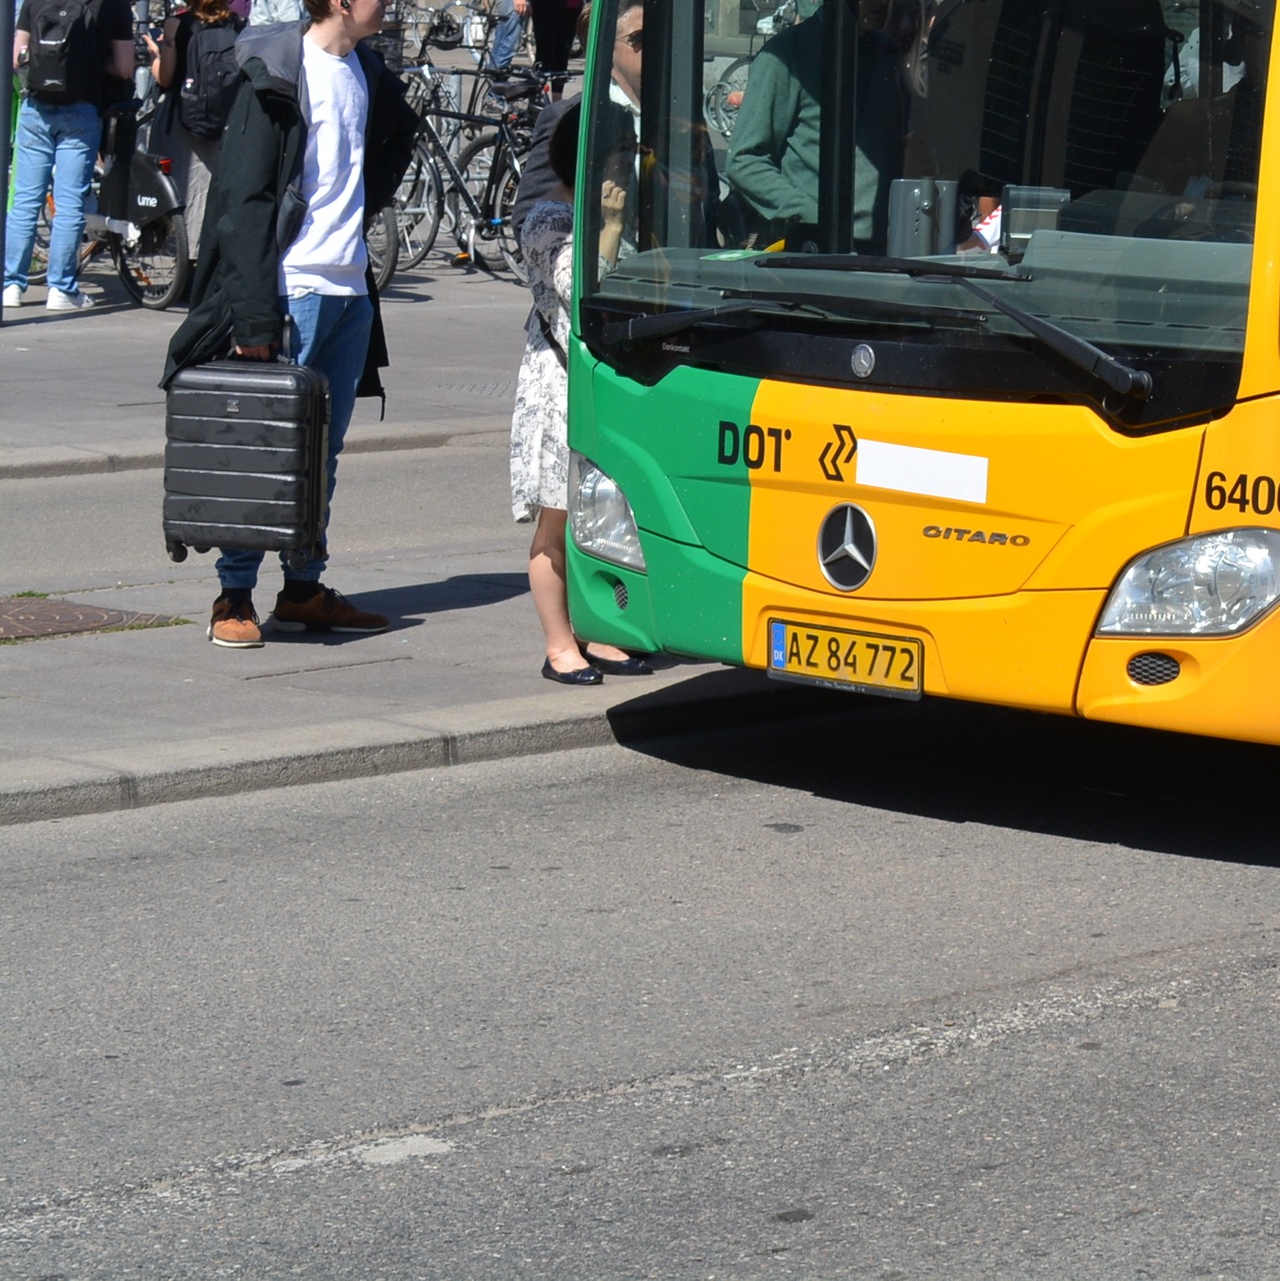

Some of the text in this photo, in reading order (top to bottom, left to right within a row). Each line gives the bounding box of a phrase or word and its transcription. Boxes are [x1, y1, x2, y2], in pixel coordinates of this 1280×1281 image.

[717, 420, 791, 473] DOT
[922, 525, 1031, 548] CITARO
[773, 650, 784, 661] DK
[788, 632, 914, 682] AZ 84 772
